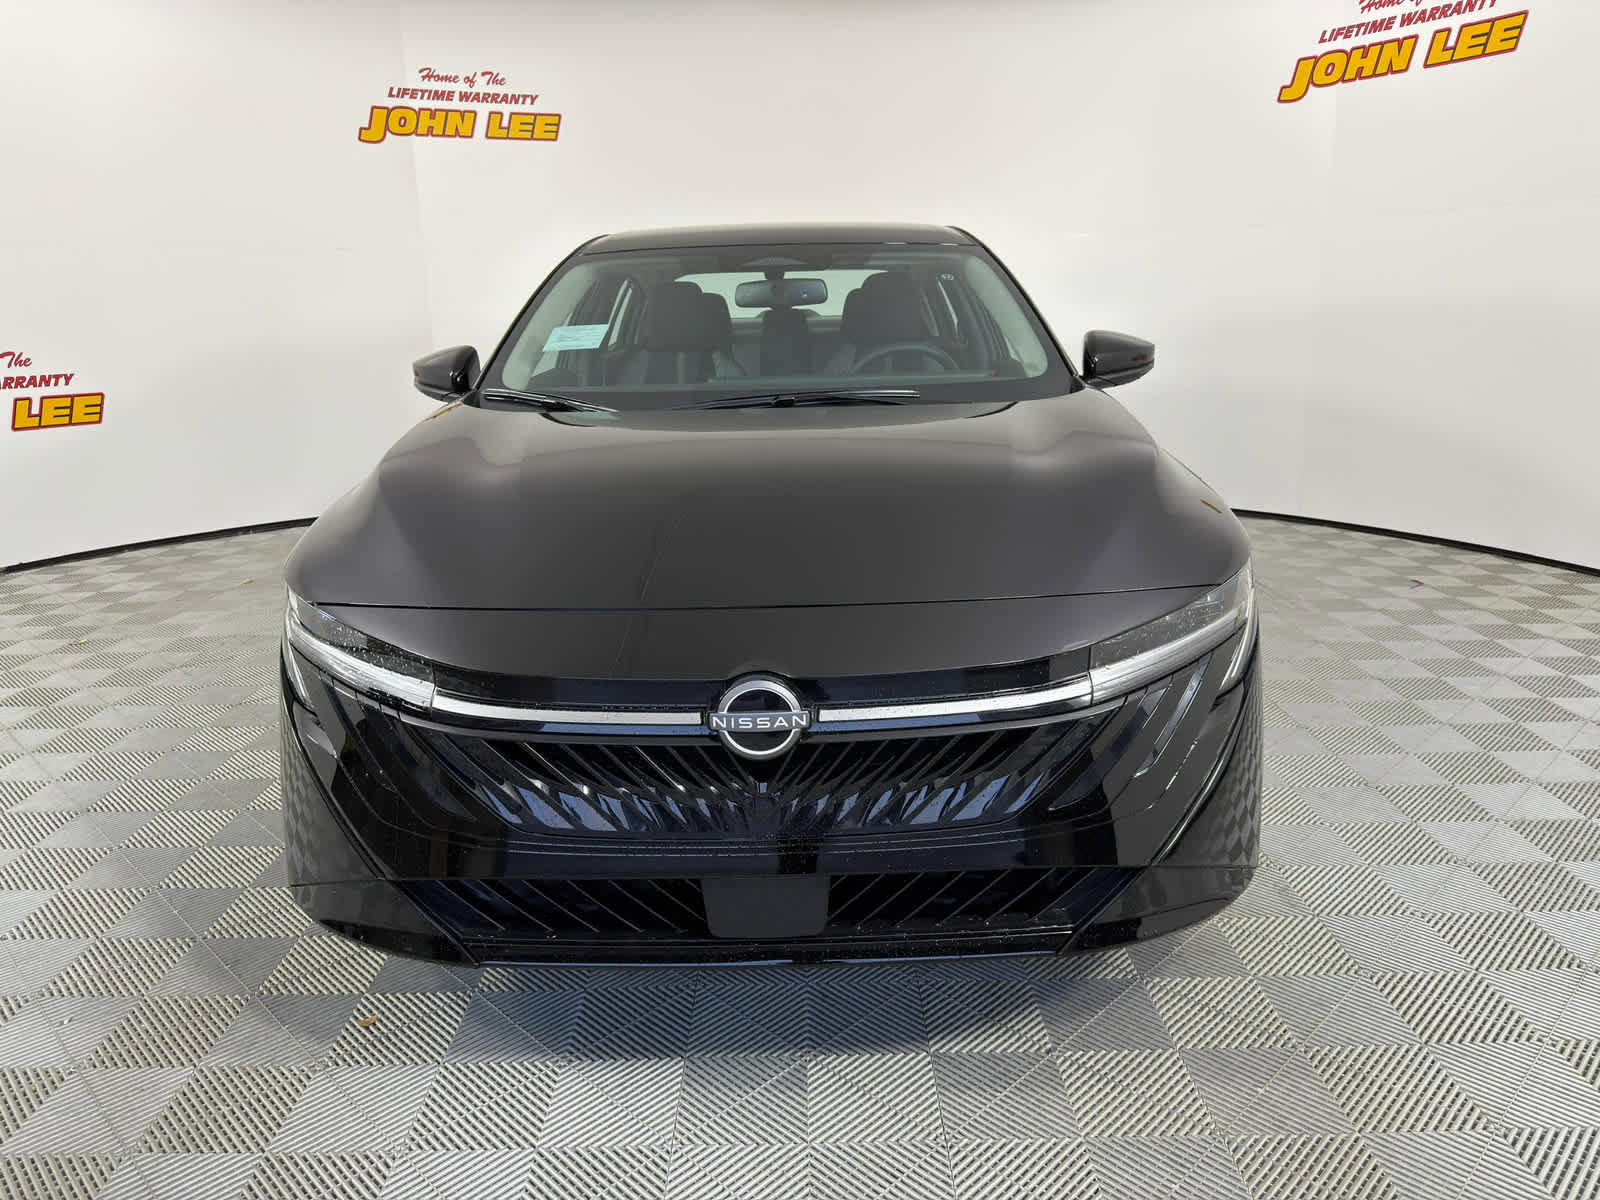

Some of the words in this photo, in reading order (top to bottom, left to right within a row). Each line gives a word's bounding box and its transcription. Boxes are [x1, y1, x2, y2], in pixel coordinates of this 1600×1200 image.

[1318, 16, 1397, 44] LIFETIME
[1399, 0, 1498, 28] WARRANTY
[1277, 34, 1419, 103] JOHN
[1423, 10, 1529, 68] LEE
[418, 67, 460, 83] Home
[463, 72, 476, 88] of
[481, 71, 506, 86] The
[388, 87, 455, 102] LIFETIME
[458, 90, 539, 105] WARRANTY
[358, 105, 477, 144] JOHN
[485, 111, 562, 142] LEE
[0, 351, 32, 369] The
[0, 373, 75, 390] RRANTY
[11, 392, 105, 432] LEE
[712, 714, 807, 729] NISSAN
